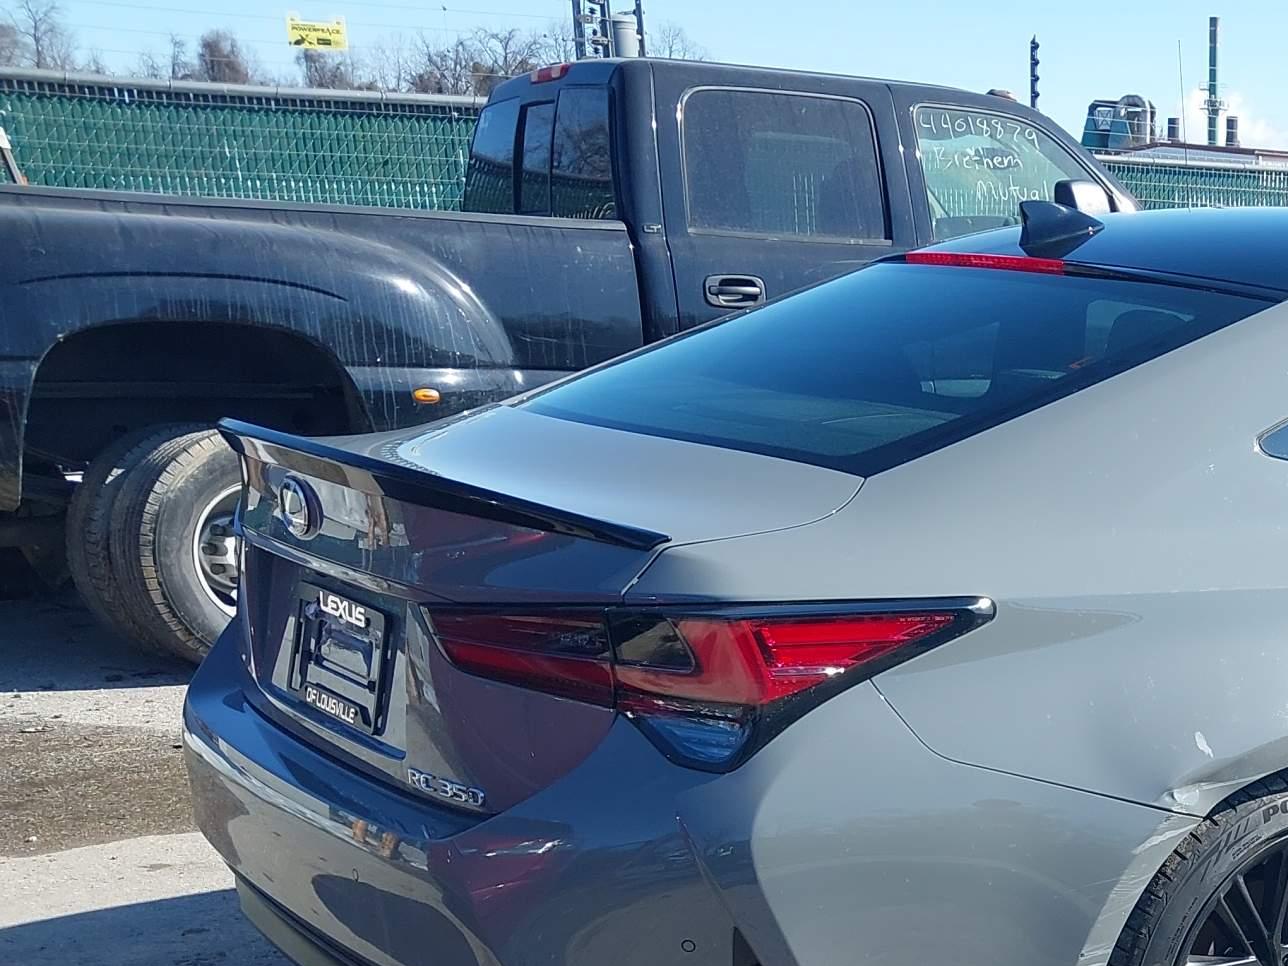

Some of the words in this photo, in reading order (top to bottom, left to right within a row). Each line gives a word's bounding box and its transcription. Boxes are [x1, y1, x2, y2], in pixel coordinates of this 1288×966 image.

[919, 112, 1039, 149] 44018879
[320, 591, 365, 627] LEXUS
[306, 686, 317, 703] OF
[316, 691, 355, 723] LOUISVILLE
[407, 768, 433, 791] RC
[438, 778, 485, 806] 350
